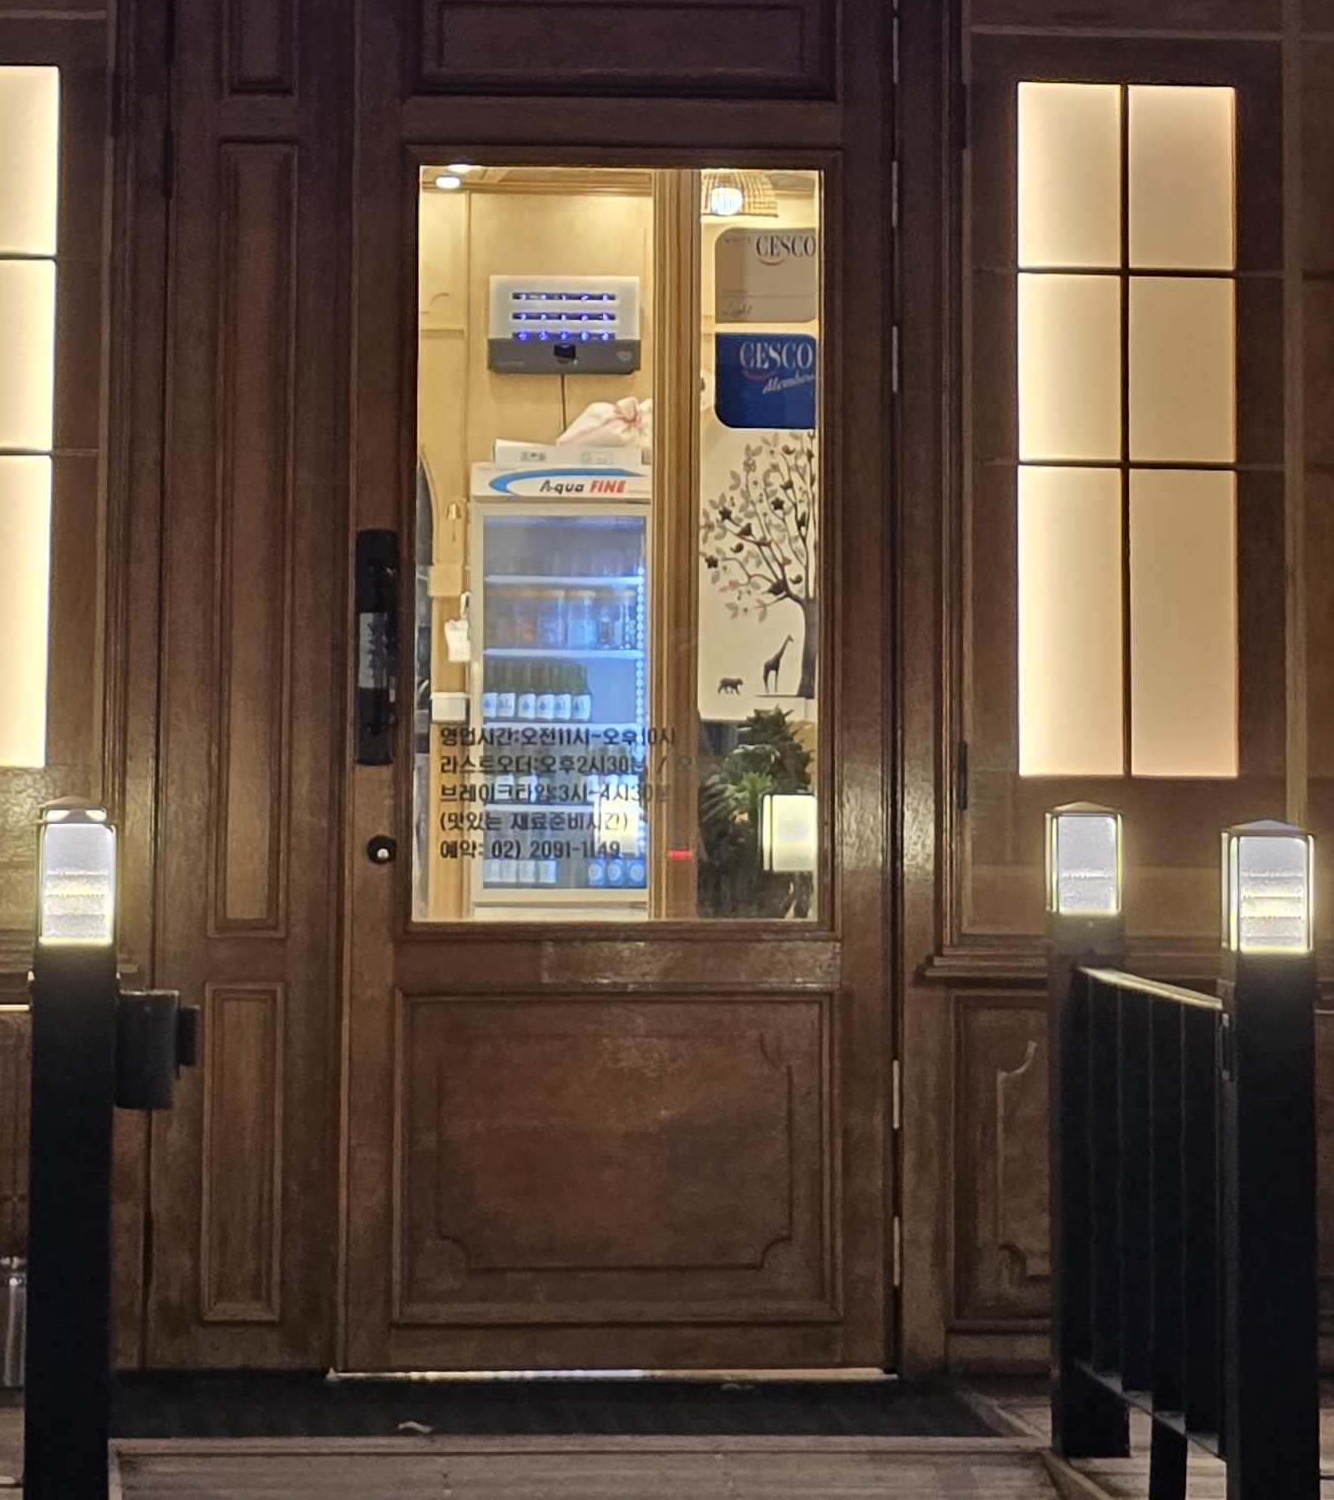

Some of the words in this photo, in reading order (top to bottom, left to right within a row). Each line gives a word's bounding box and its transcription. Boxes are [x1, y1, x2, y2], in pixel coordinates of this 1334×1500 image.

[756, 235, 816, 258] CESCO
[739, 341, 813, 369] CESCO
[539, 479, 585, 495] Aqua
[589, 480, 627, 494] FINE
[440, 811, 503, 832] (맛있는
[440, 840, 483, 860] 예약:
[491, 841, 521, 860] 02)
[530, 841, 621, 860] 2091-1149
